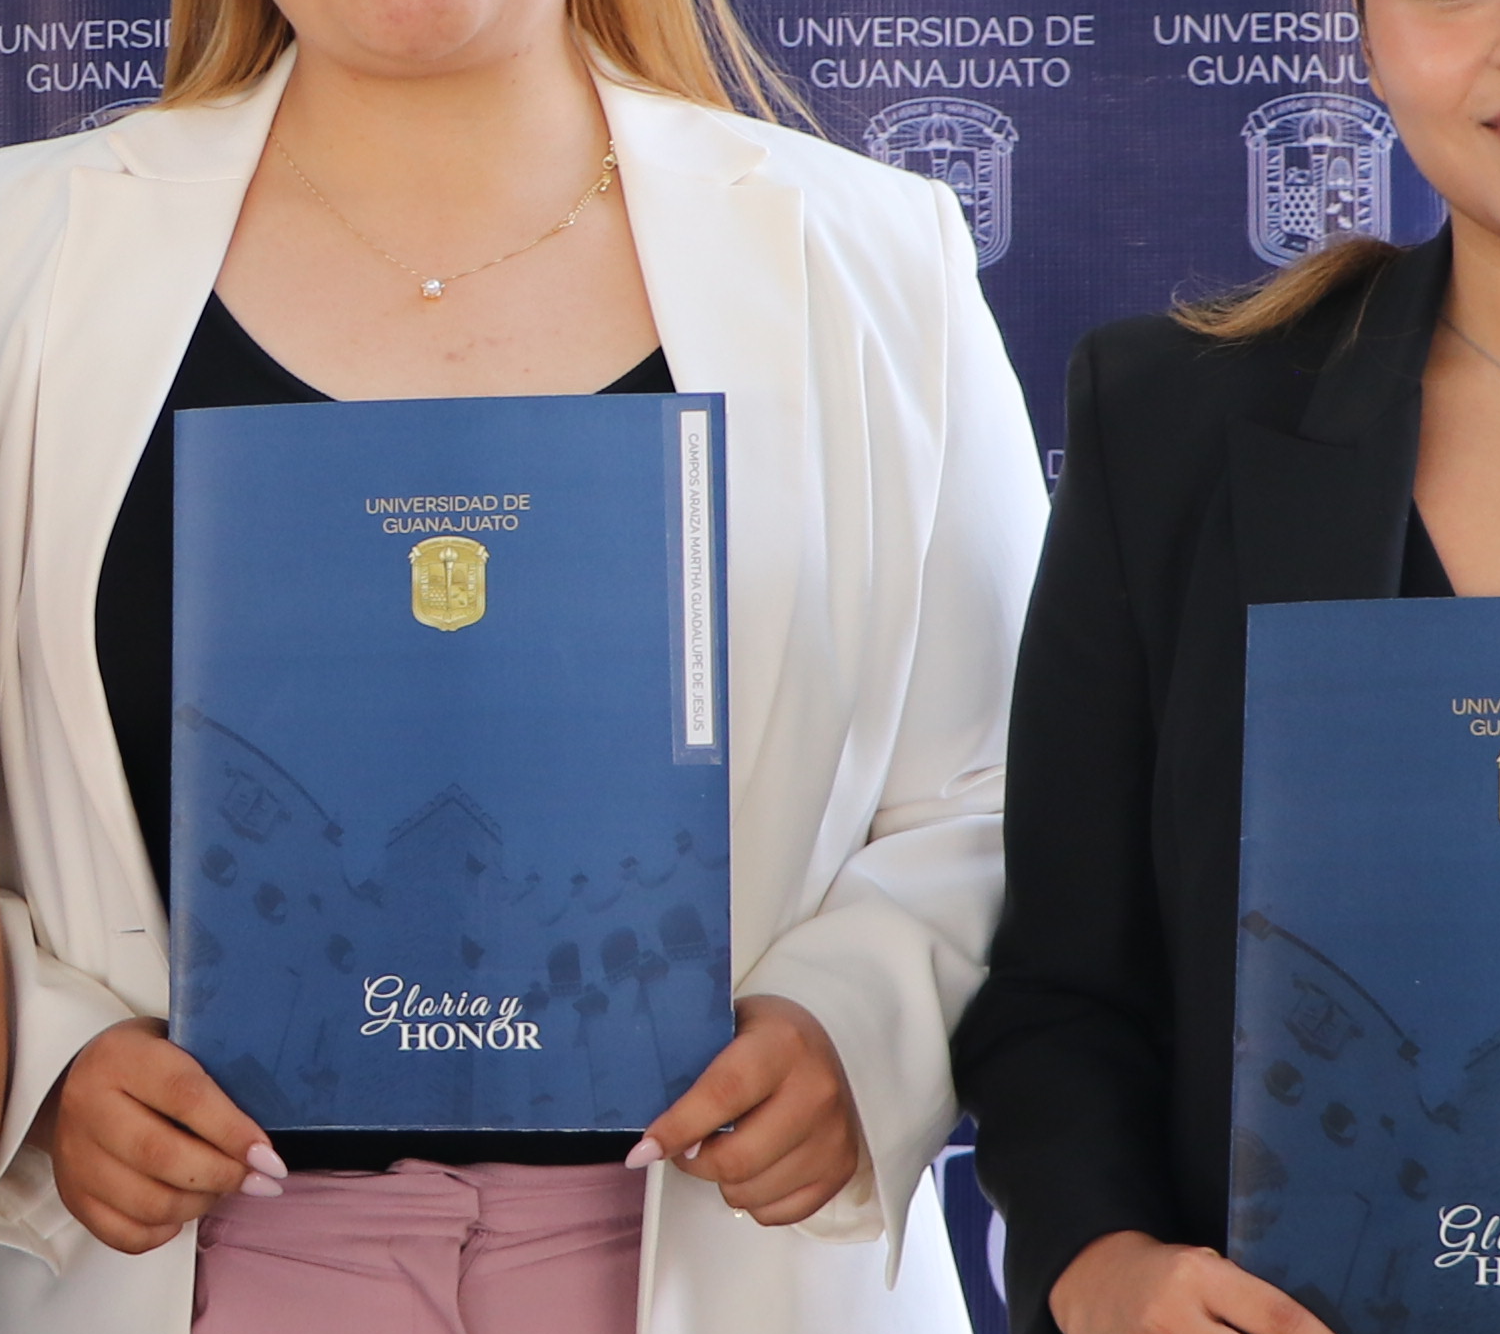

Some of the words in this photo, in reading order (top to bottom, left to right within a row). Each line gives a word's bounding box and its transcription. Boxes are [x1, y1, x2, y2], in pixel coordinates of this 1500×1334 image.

[777, 15, 1034, 48] UNIVERSIDAD
[1045, 15, 1095, 46] DE
[1153, 12, 1361, 46] UNIVERSID
[26, 60, 164, 93] GUANA
[810, 57, 1070, 89] GUANAJUATO
[1187, 53, 1370, 86] GUANAJU
[687, 433, 700, 486] CAMPOS
[365, 495, 498, 514] UNIVERSIDAD
[503, 494, 531, 511] DE
[689, 488, 701, 533] ARAIZA
[383, 514, 518, 534] GUANAJUATO
[690, 536, 702, 591] MARTHA
[691, 593, 703, 670] GUADALUPE
[692, 672, 703, 690] DE
[693, 692, 705, 731] JESUS
[360, 975, 491, 1035] Gloria
[492, 997, 523, 1031] y
[398, 1022, 542, 1051] HONOR
